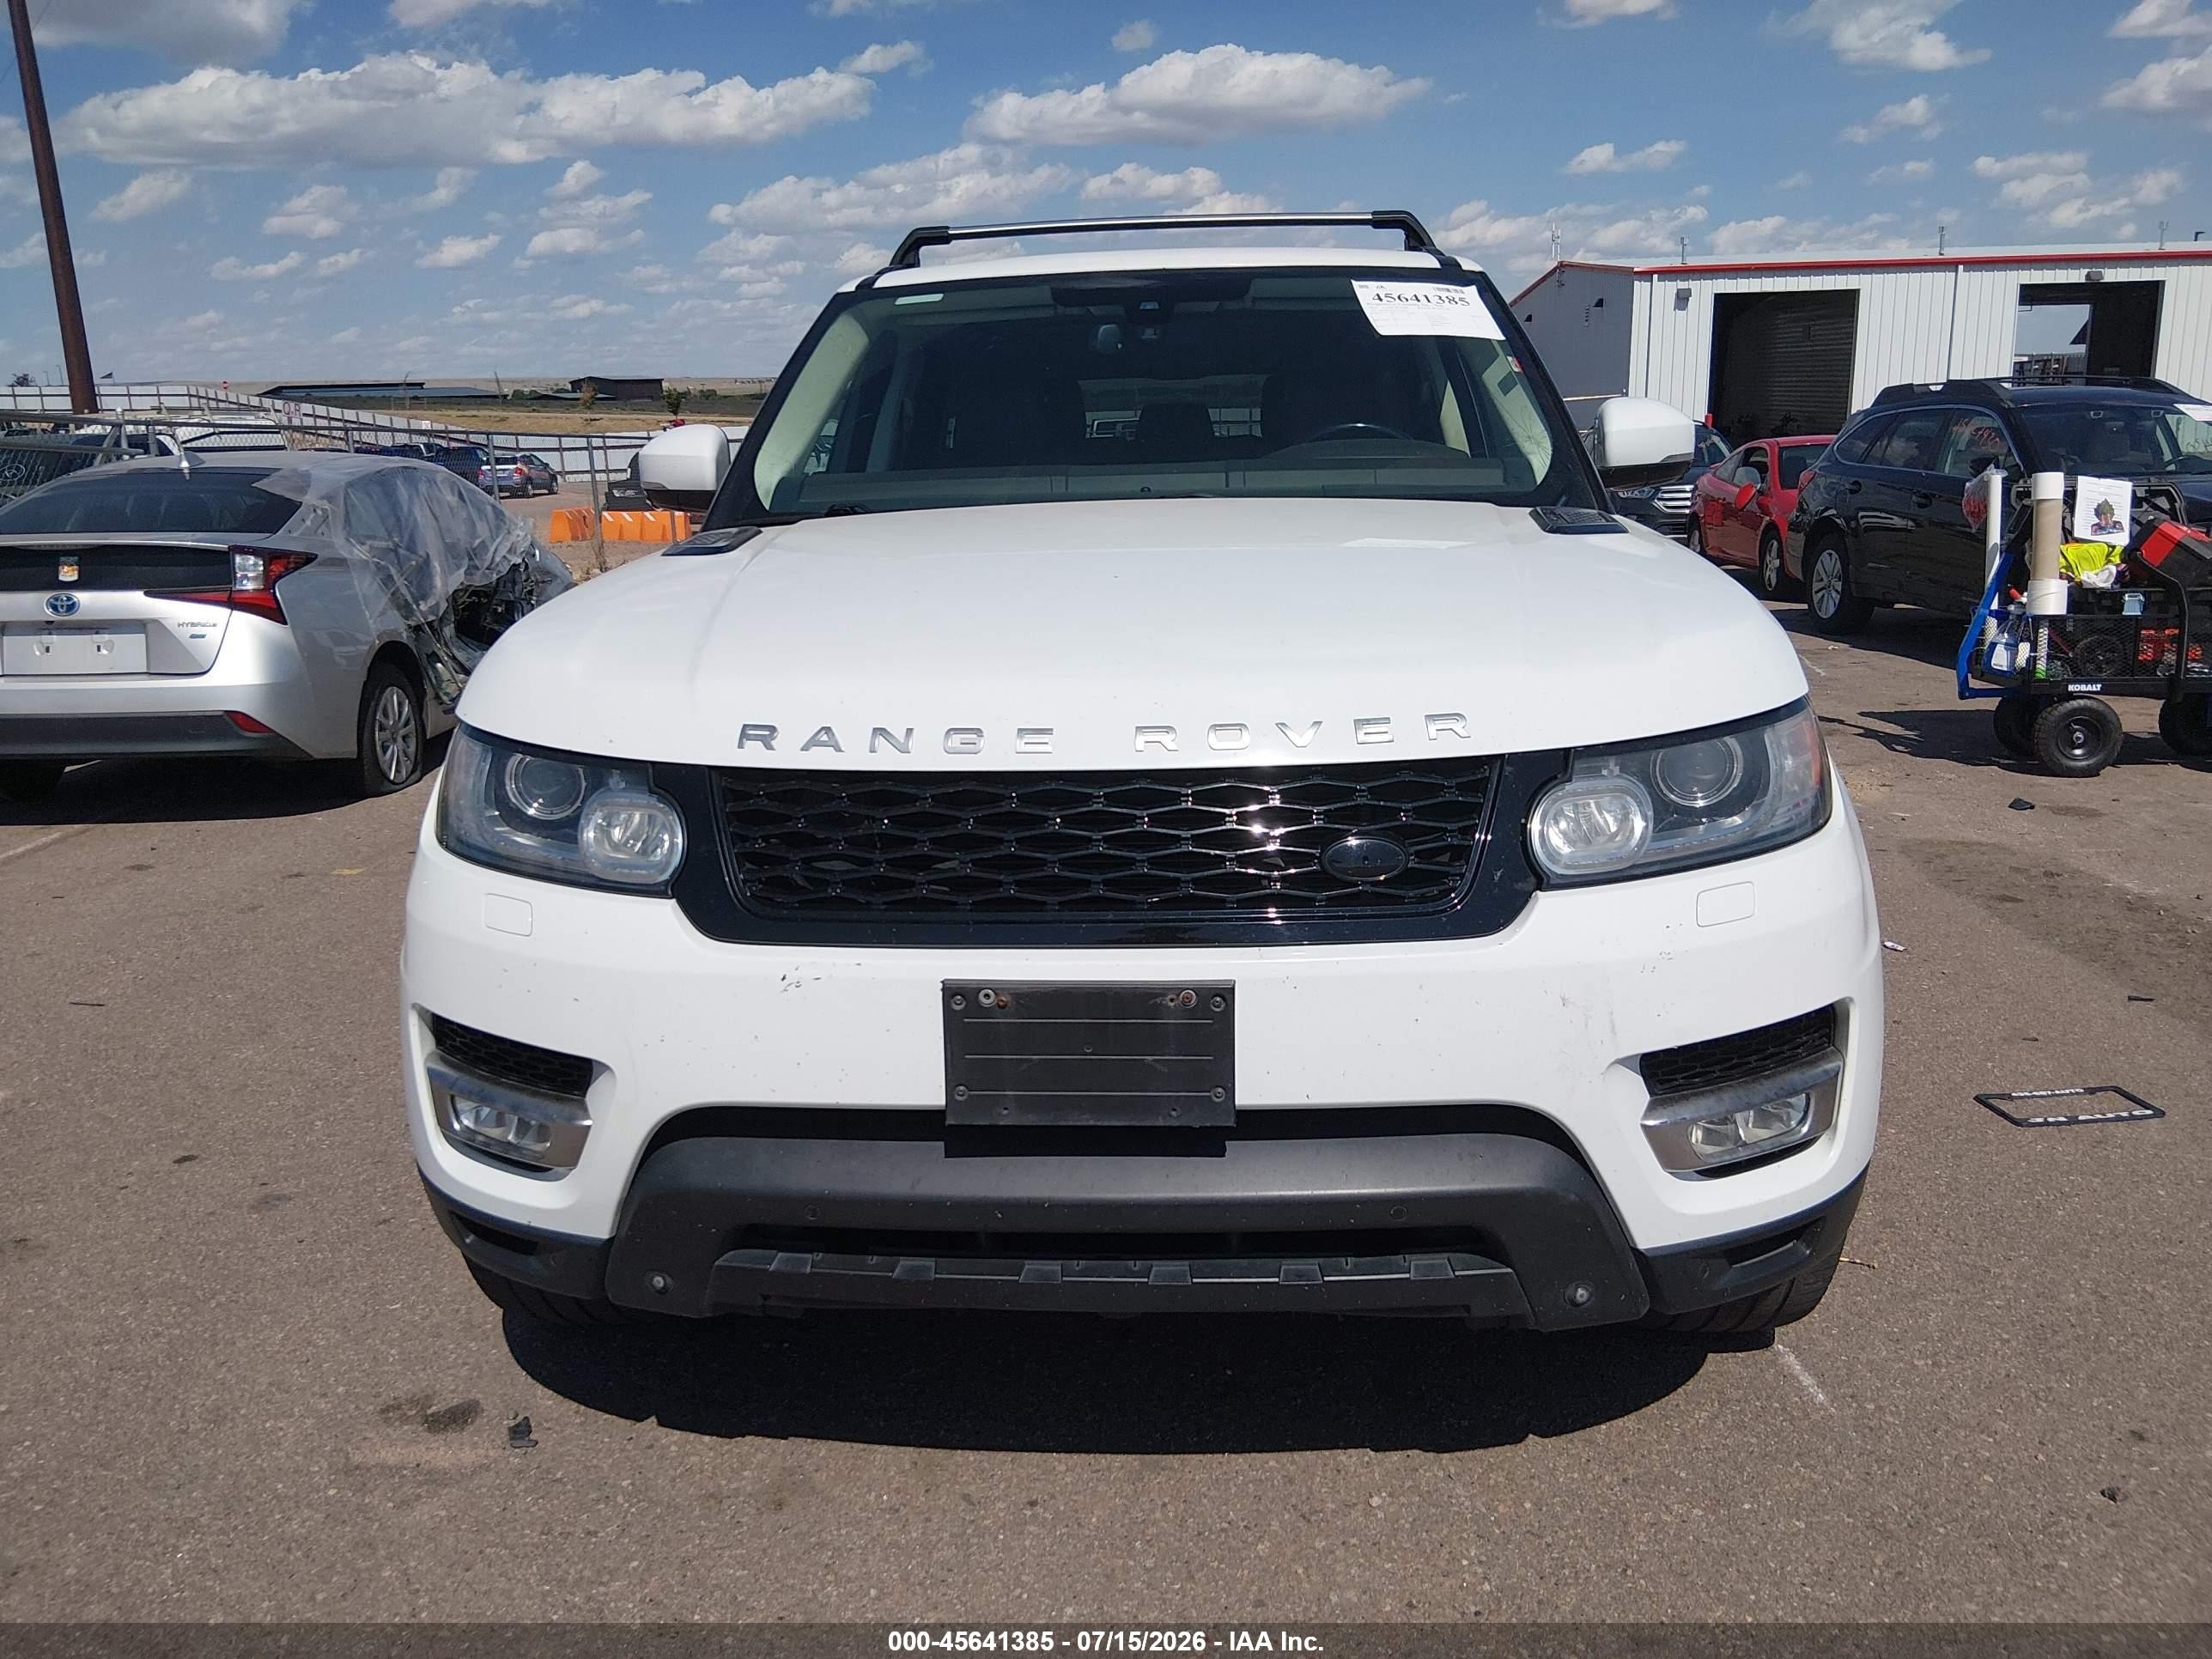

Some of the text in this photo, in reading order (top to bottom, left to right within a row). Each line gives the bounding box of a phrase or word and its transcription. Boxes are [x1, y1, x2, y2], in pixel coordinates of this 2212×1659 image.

[1372, 292, 1471, 307] 45641385
[2068, 684, 2103, 692] KOBALT
[737, 712, 1471, 755] RANGE ROVER
[2078, 1109, 2154, 1120] AUTO
